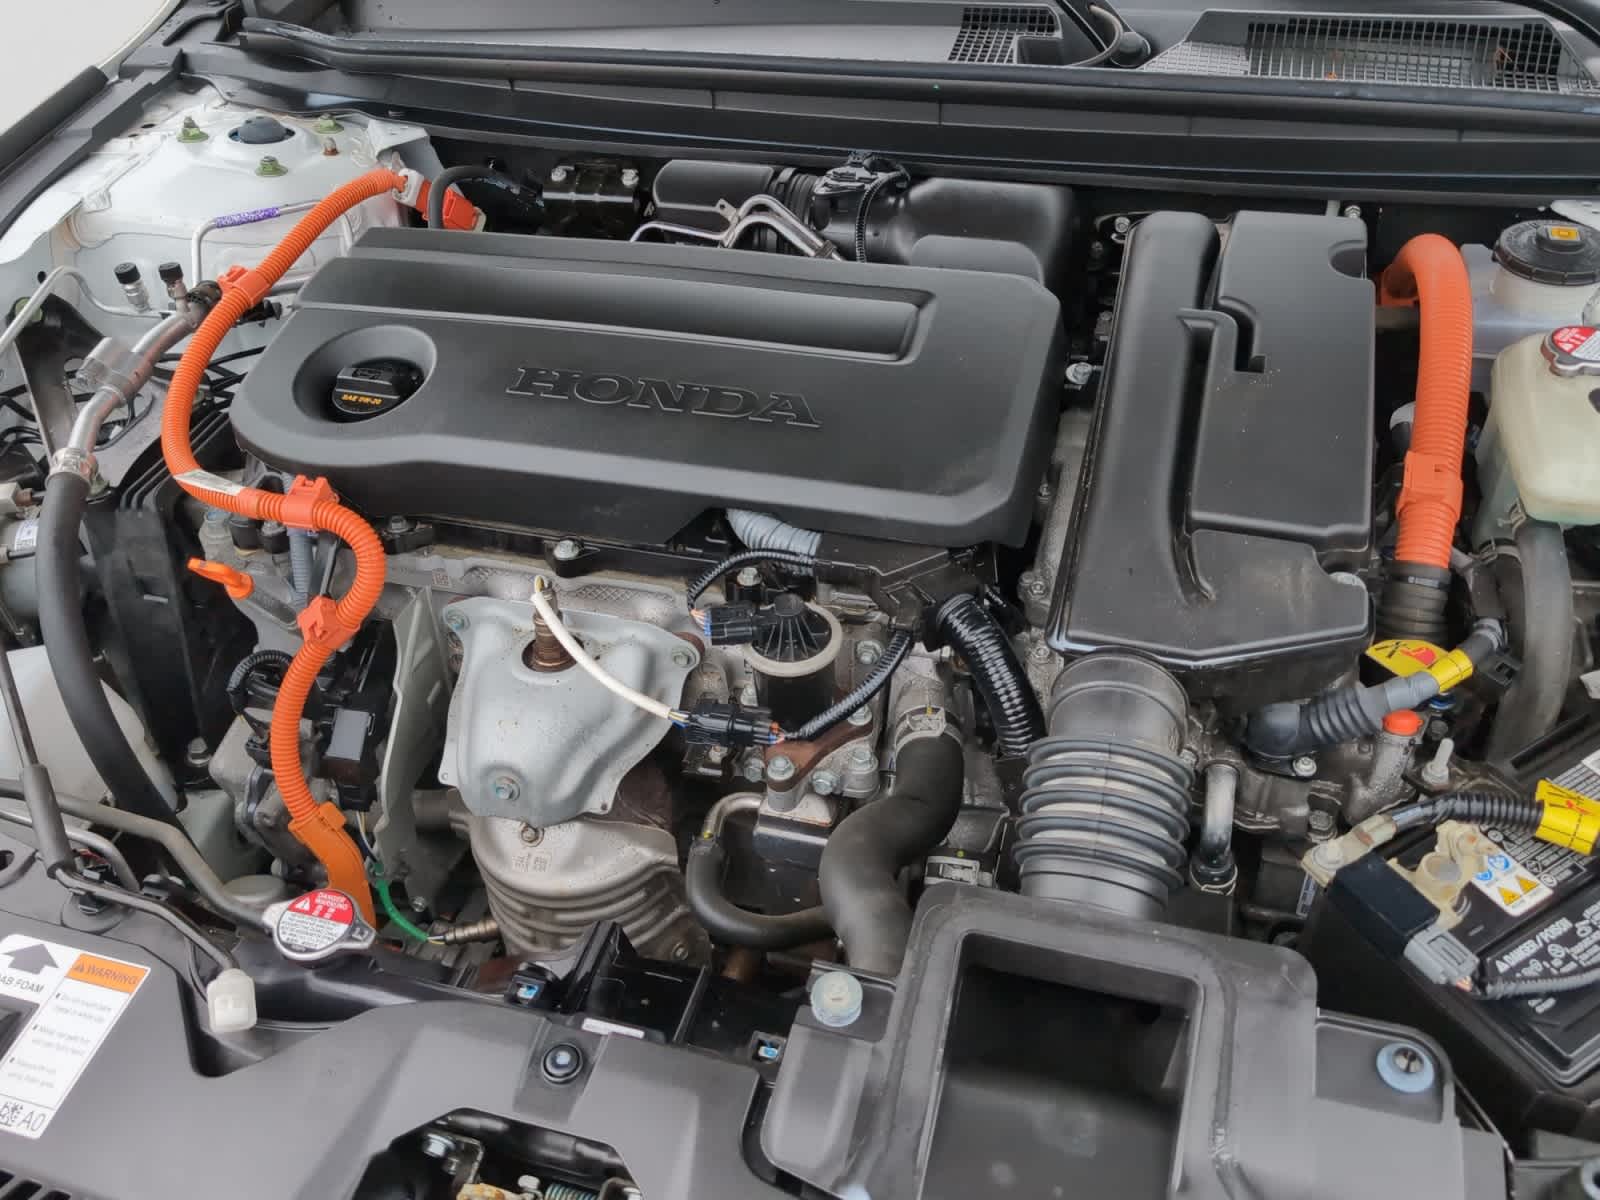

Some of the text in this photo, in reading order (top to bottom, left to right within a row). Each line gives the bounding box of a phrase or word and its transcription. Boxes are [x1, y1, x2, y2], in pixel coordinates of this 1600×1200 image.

[341, 393, 382, 405] SAE 0W-20
[506, 367, 822, 427] HONDA
[86, 964, 139, 985] WARNING
[14, 978, 44, 993] FOAM
